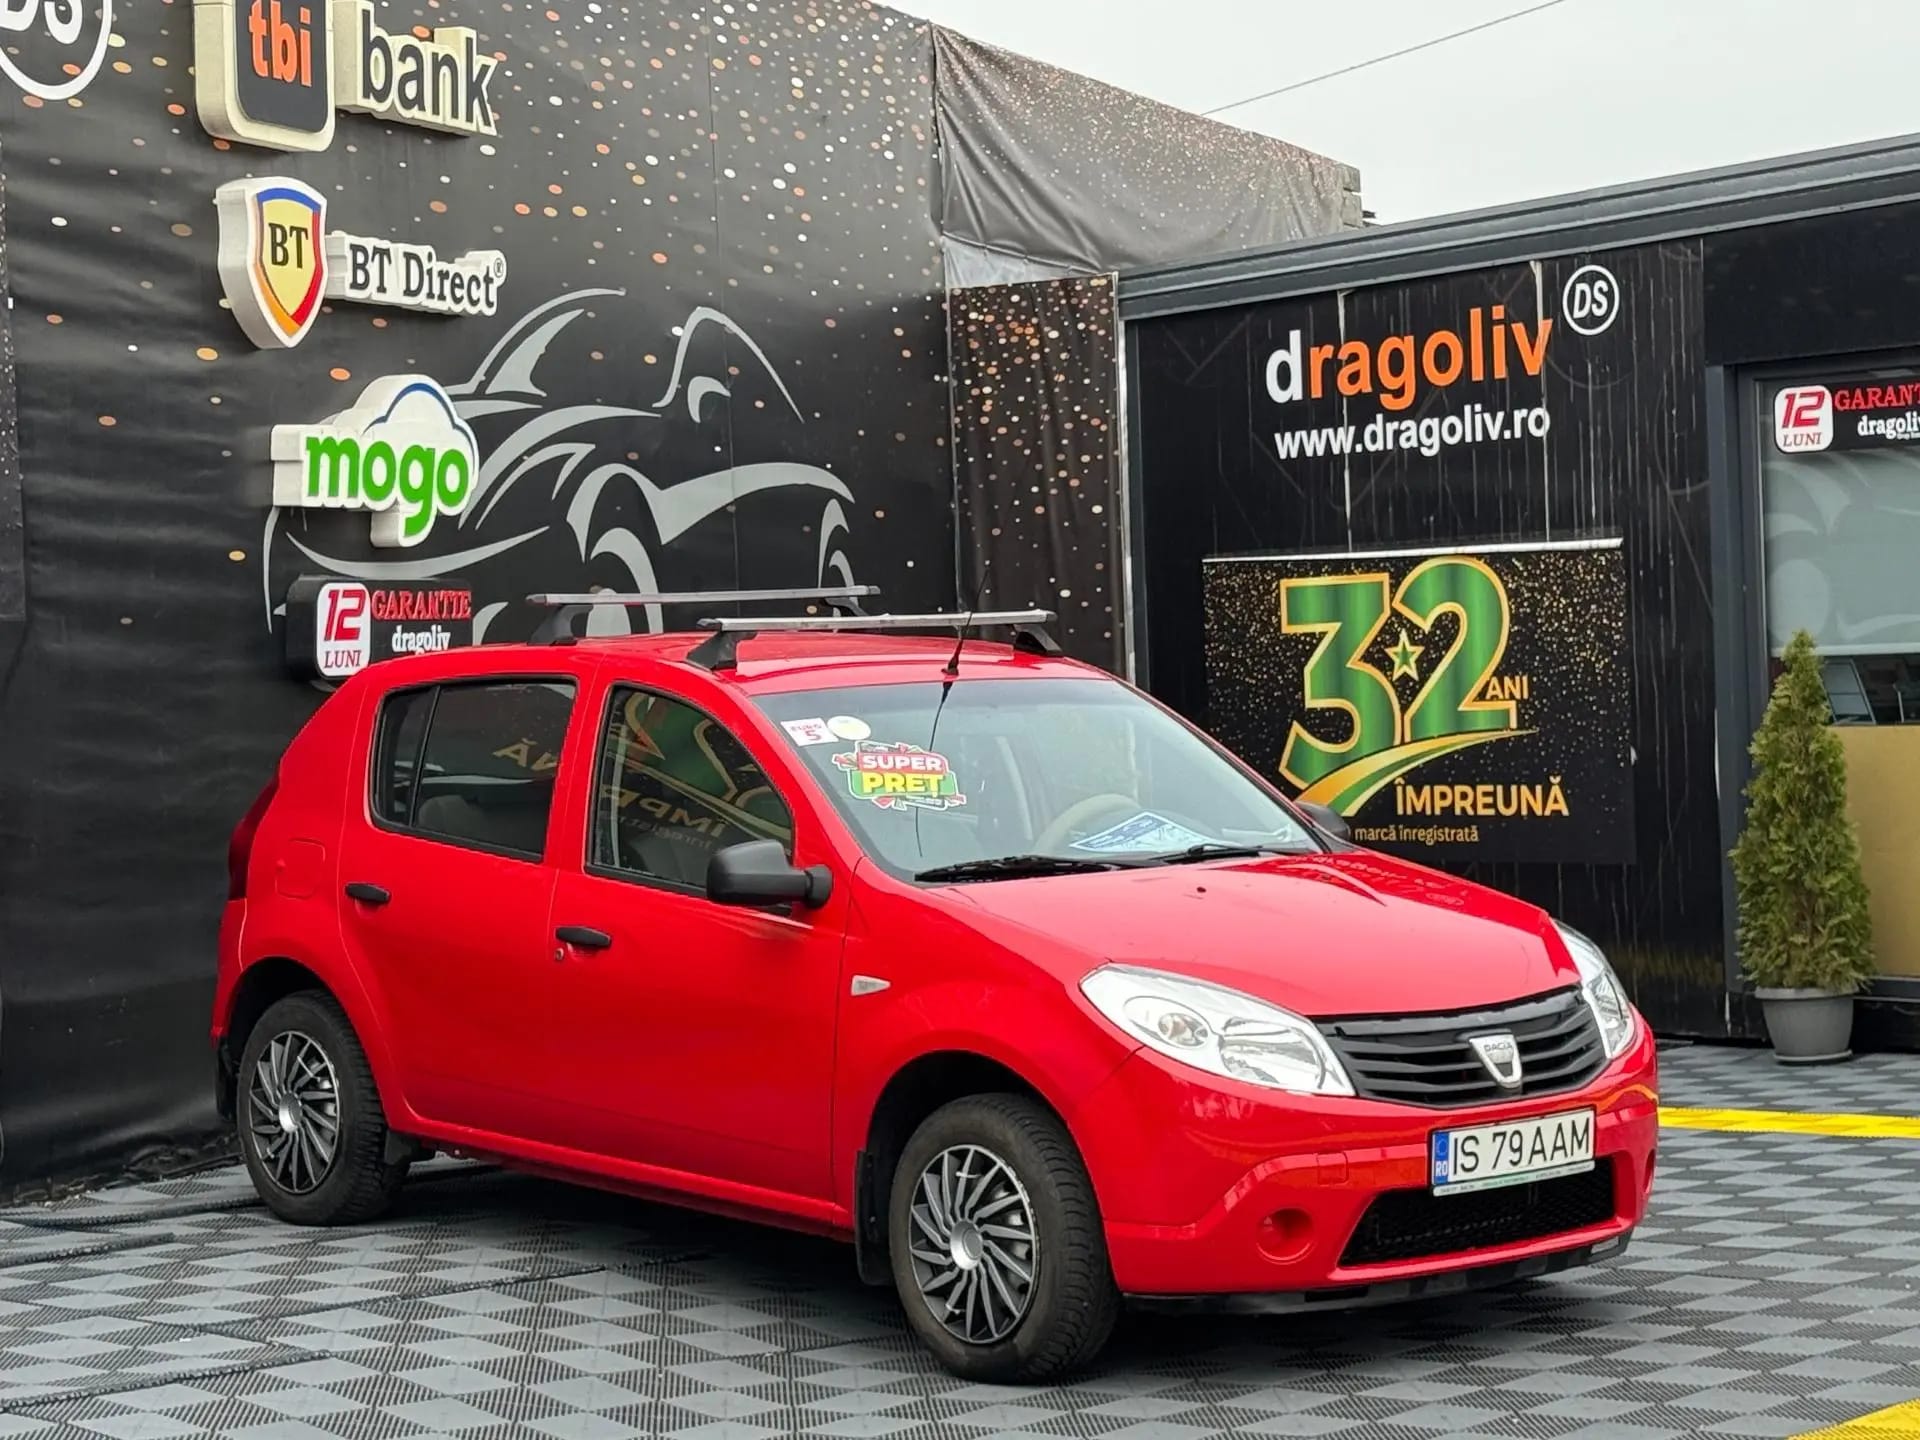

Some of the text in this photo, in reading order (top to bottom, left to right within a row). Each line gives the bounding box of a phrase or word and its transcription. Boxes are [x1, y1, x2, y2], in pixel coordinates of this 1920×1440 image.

[248, 0, 492, 128] tbi bank
[268, 222, 309, 268] BT
[349, 244, 392, 293] BT
[1572, 280, 1609, 319] DS
[1265, 305, 1553, 411] dragoliv
[1781, 390, 1826, 429] 12
[1857, 410, 1920, 440] dragoli
[1274, 405, 1551, 460] www.dragoliv.ro
[1783, 432, 1822, 447] LUNI
[305, 436, 469, 538] mogo
[324, 589, 367, 642] 12
[371, 590, 472, 620] GARANTIE
[324, 650, 362, 669] LUNI
[391, 624, 451, 656] dragoliv
[1278, 555, 1517, 789] 32
[1485, 675, 1529, 700] ANI
[863, 754, 942, 772] SUPER
[1394, 773, 1570, 817] ÎMPREUNĂ
[1354, 825, 1480, 846] marcă înregistrată
[1435, 1160, 1449, 1176] RO
[1453, 1135, 1480, 1175] IS
